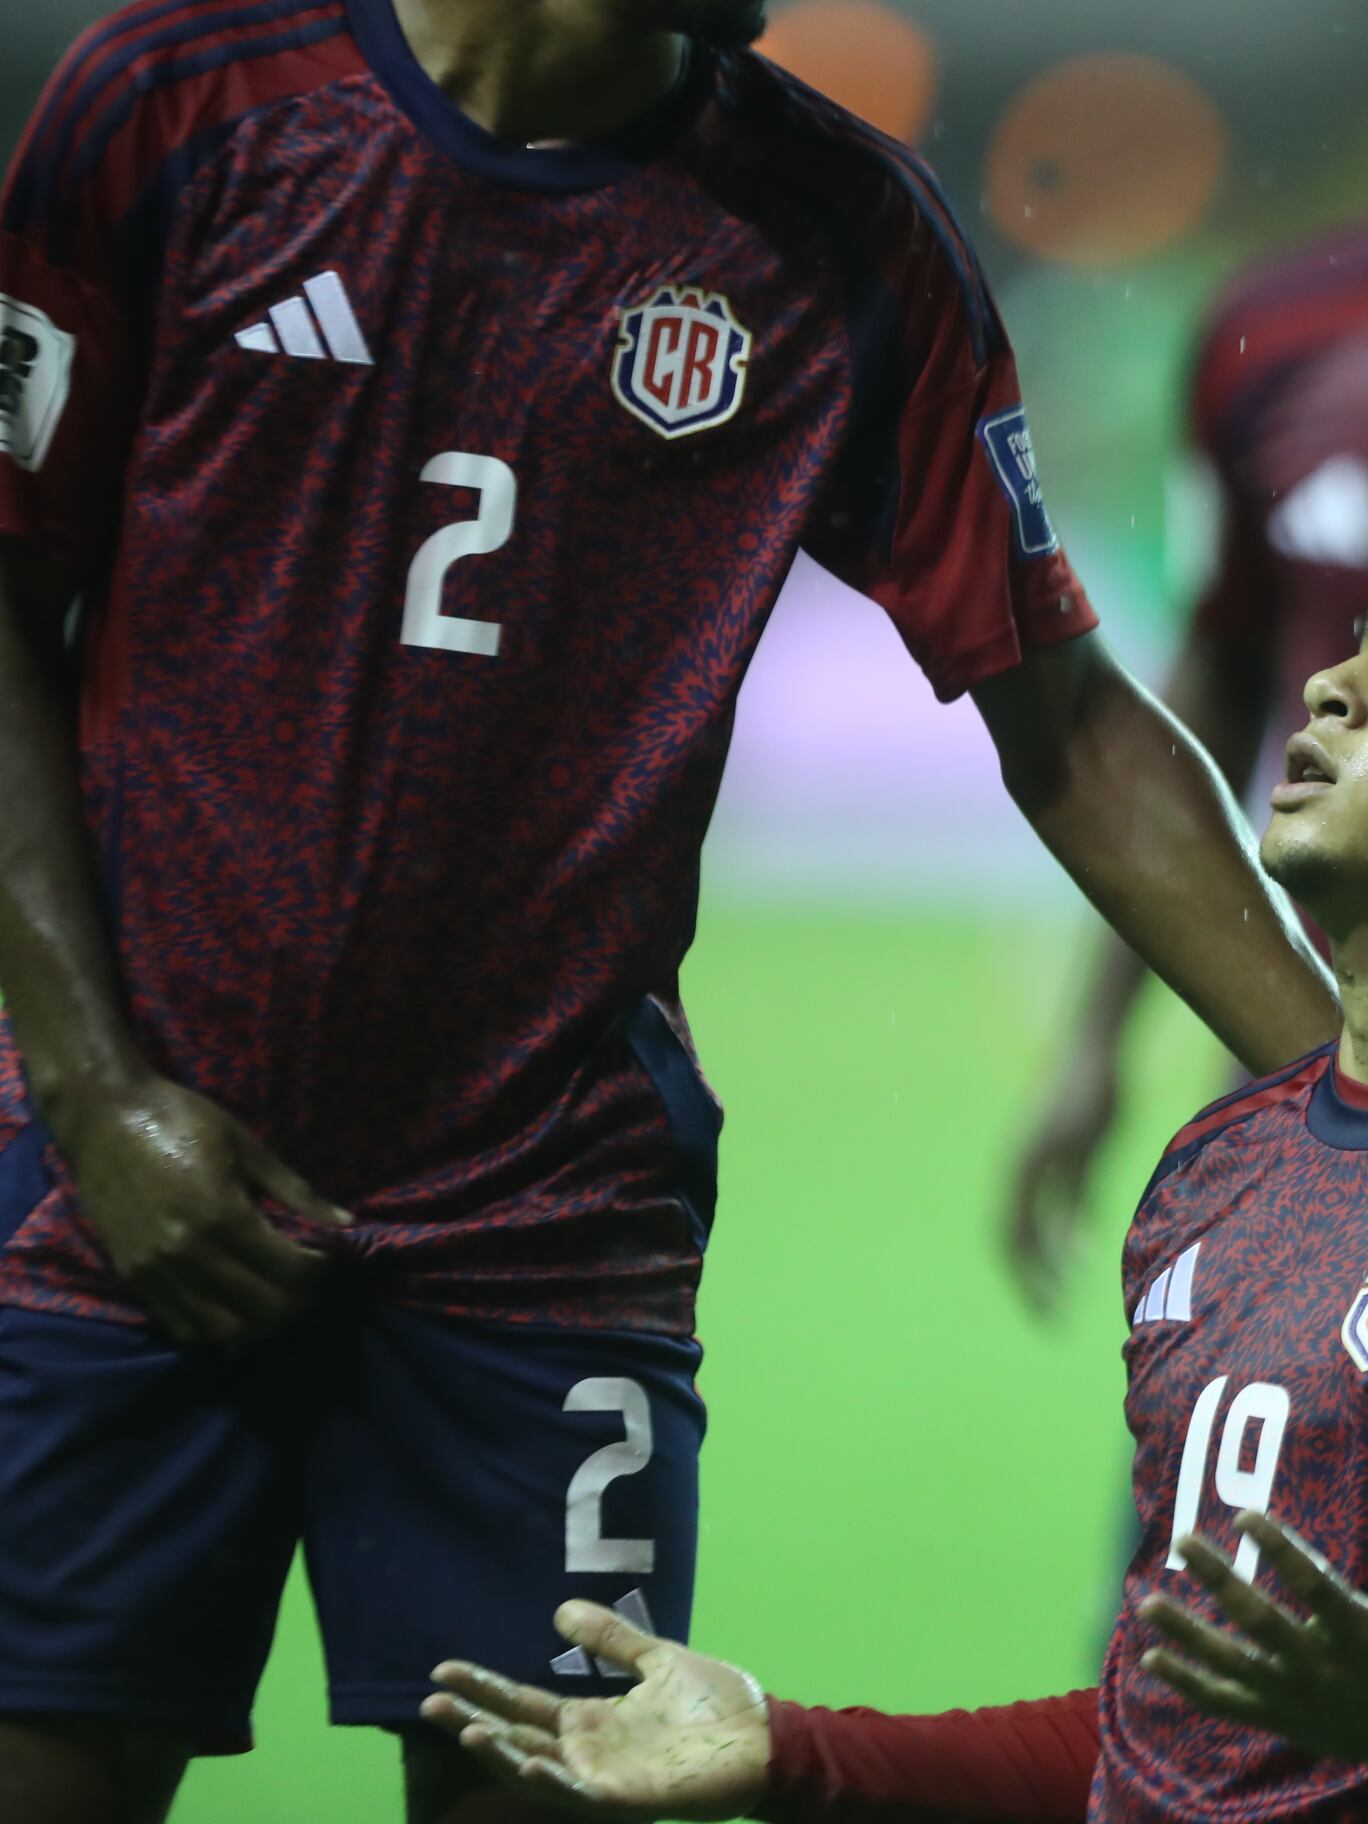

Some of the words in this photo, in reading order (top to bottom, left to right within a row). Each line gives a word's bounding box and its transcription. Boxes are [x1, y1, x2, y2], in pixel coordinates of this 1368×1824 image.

[643, 317, 720, 411] CR
[401, 451, 517, 656] 2
[562, 1377, 655, 1574] 2
[1165, 1375, 1290, 1585] 19
